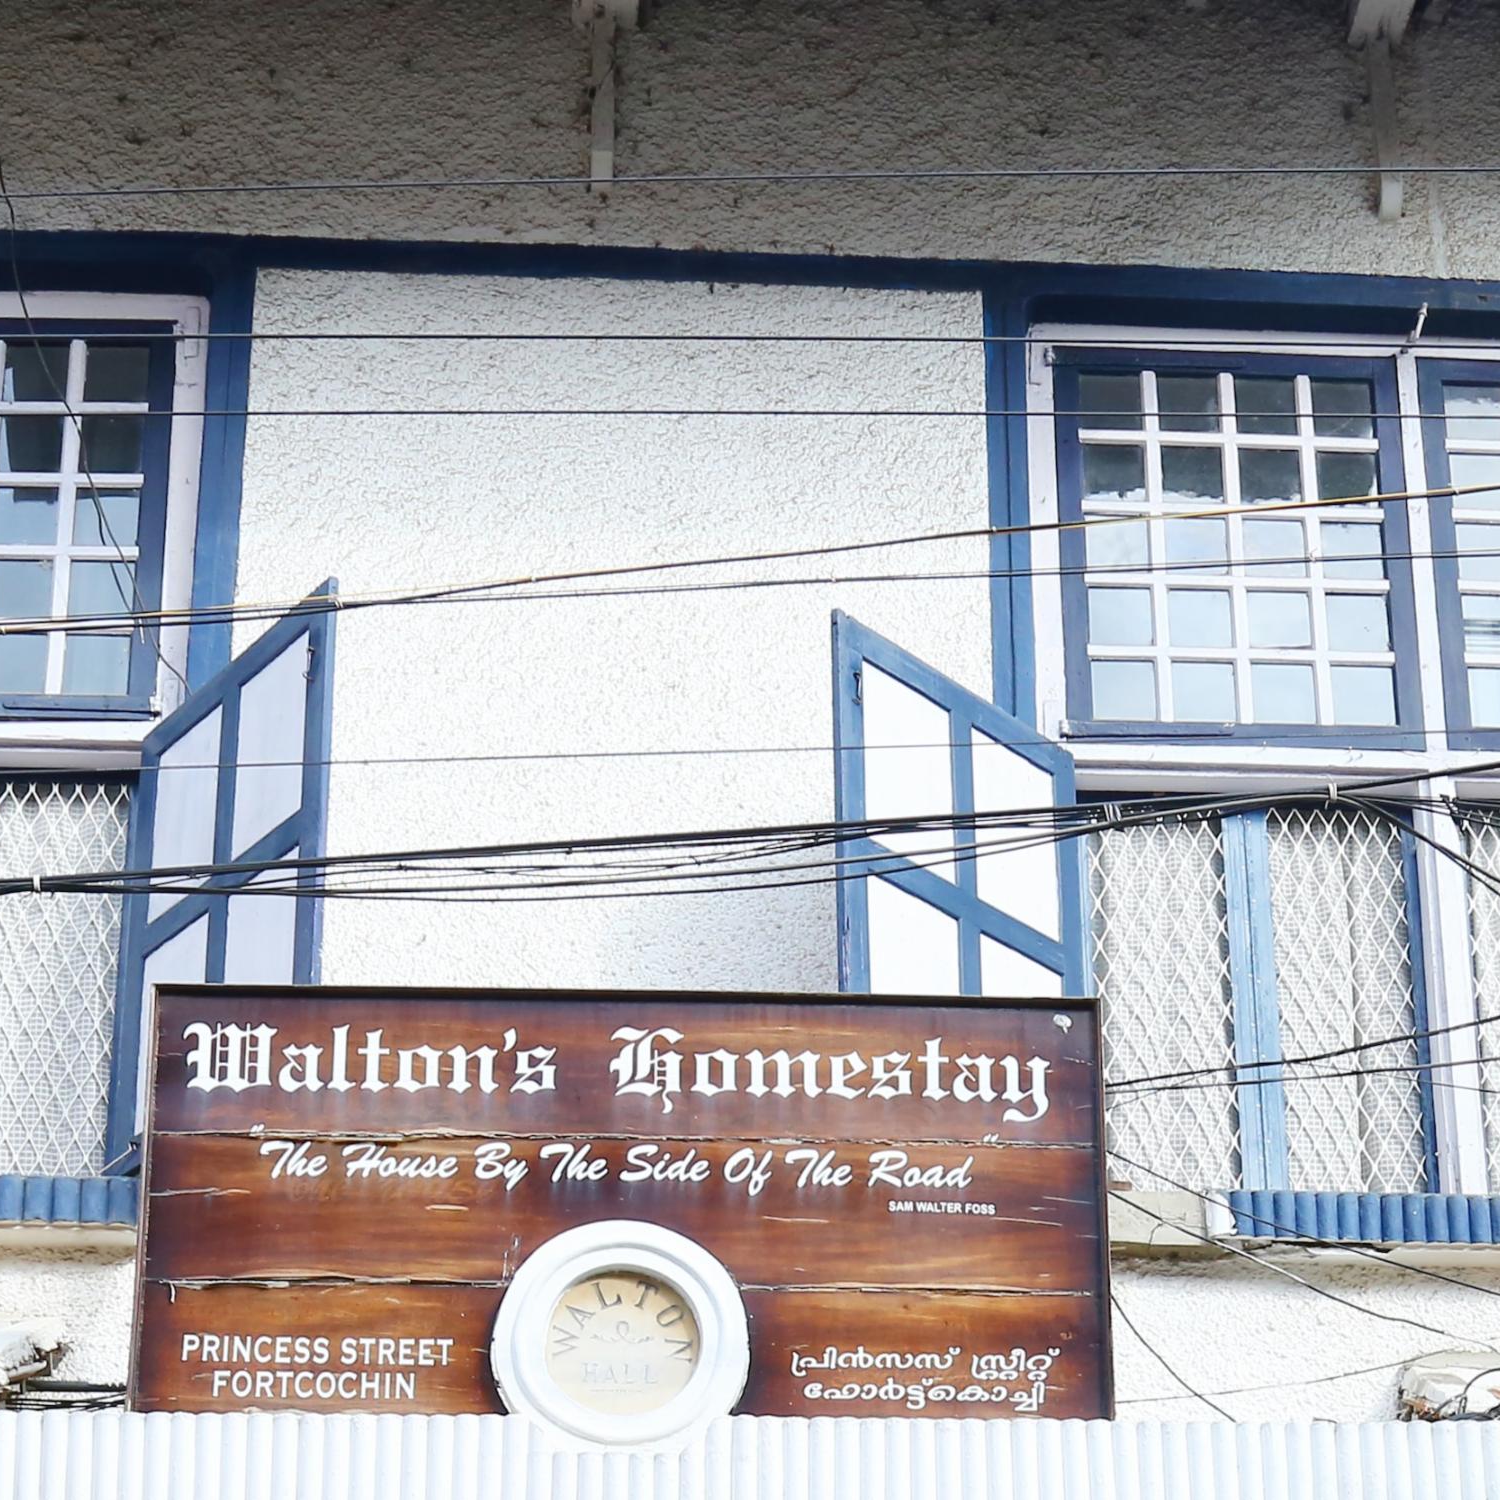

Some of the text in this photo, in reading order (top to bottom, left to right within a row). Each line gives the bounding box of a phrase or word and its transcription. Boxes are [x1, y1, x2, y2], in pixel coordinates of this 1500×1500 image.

[183, 1022, 1051, 1123] Walton's Homestay
[341, 1141, 457, 1178] House
[474, 1142, 529, 1192] By
[539, 1143, 608, 1183] The
[619, 1143, 711, 1183] Side
[723, 1147, 773, 1197] Of
[785, 1149, 853, 1188] The
[888, 1200, 997, 1215] SAM WALTER FOSS
[551, 1280, 694, 1364] WALTON
[180, 1333, 454, 1367] PRINCESS STREET
[211, 1369, 416, 1400] FORTCOCHIN
[580, 1362, 660, 1386] HALL
